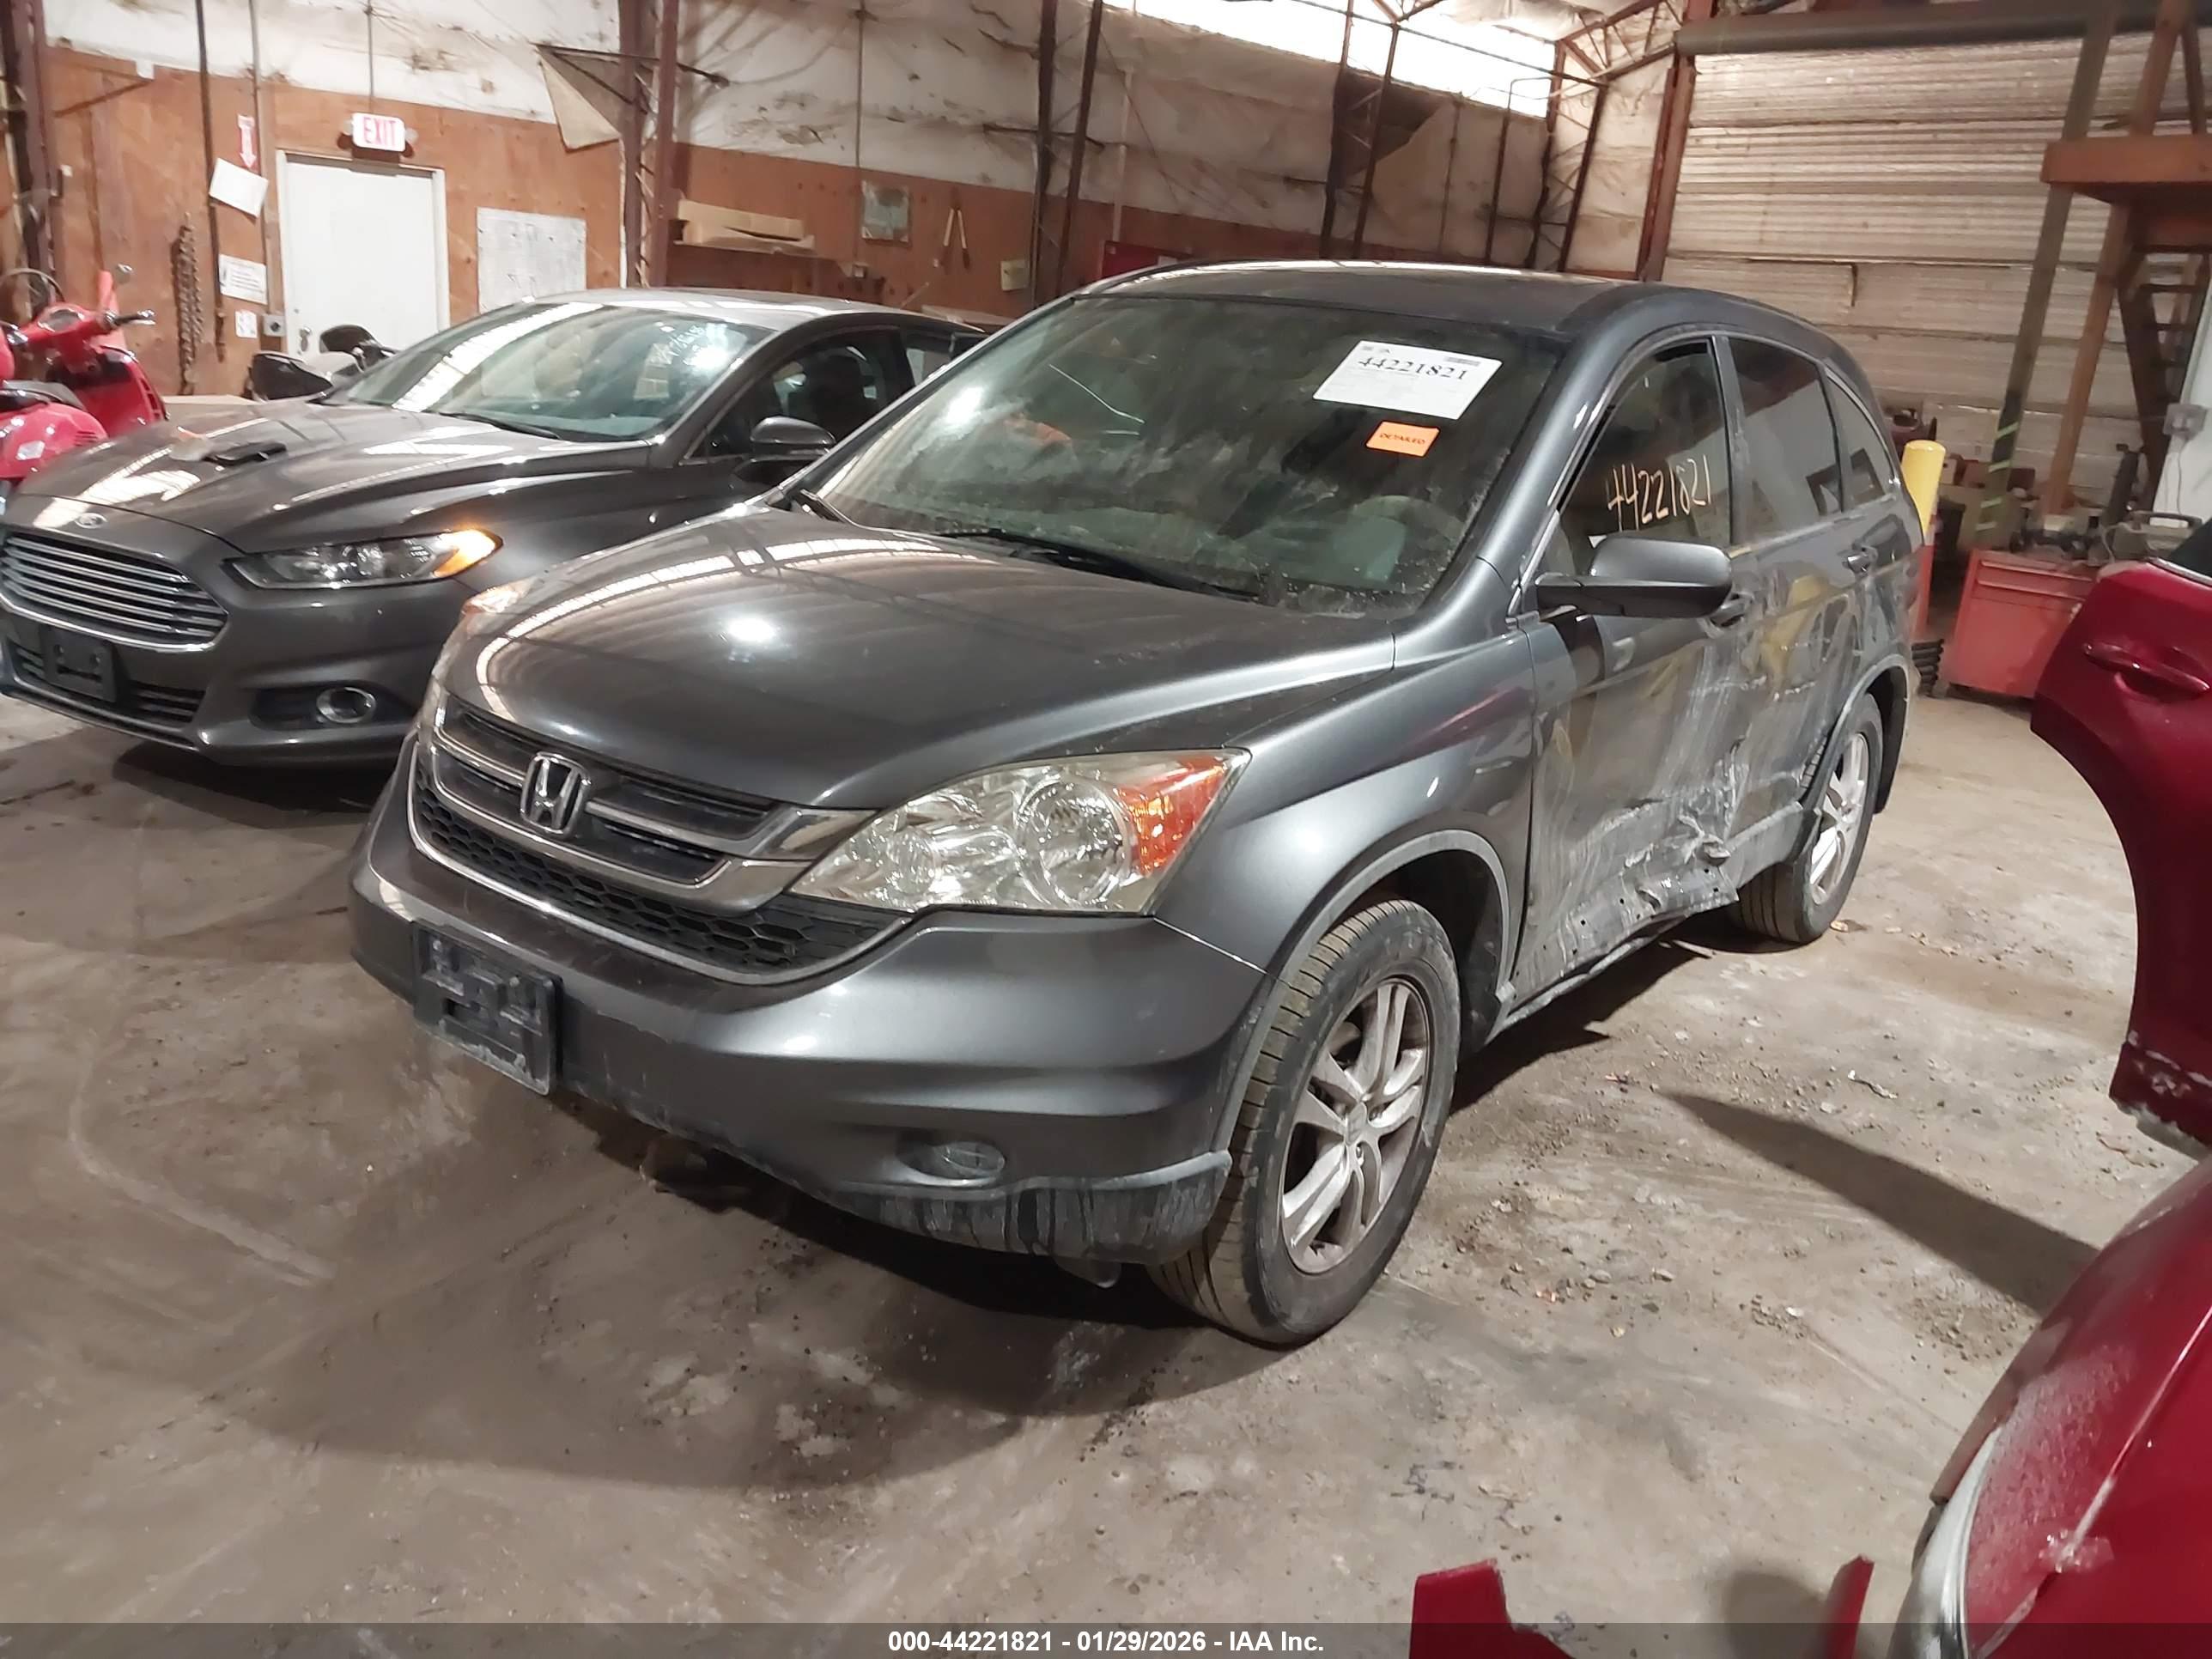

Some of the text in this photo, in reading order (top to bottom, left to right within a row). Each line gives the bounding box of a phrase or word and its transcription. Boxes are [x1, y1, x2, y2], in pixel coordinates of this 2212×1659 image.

[362, 116, 397, 147] EXIT
[1358, 356, 1468, 380] 44221821
[1606, 454, 1711, 532] 44221821
